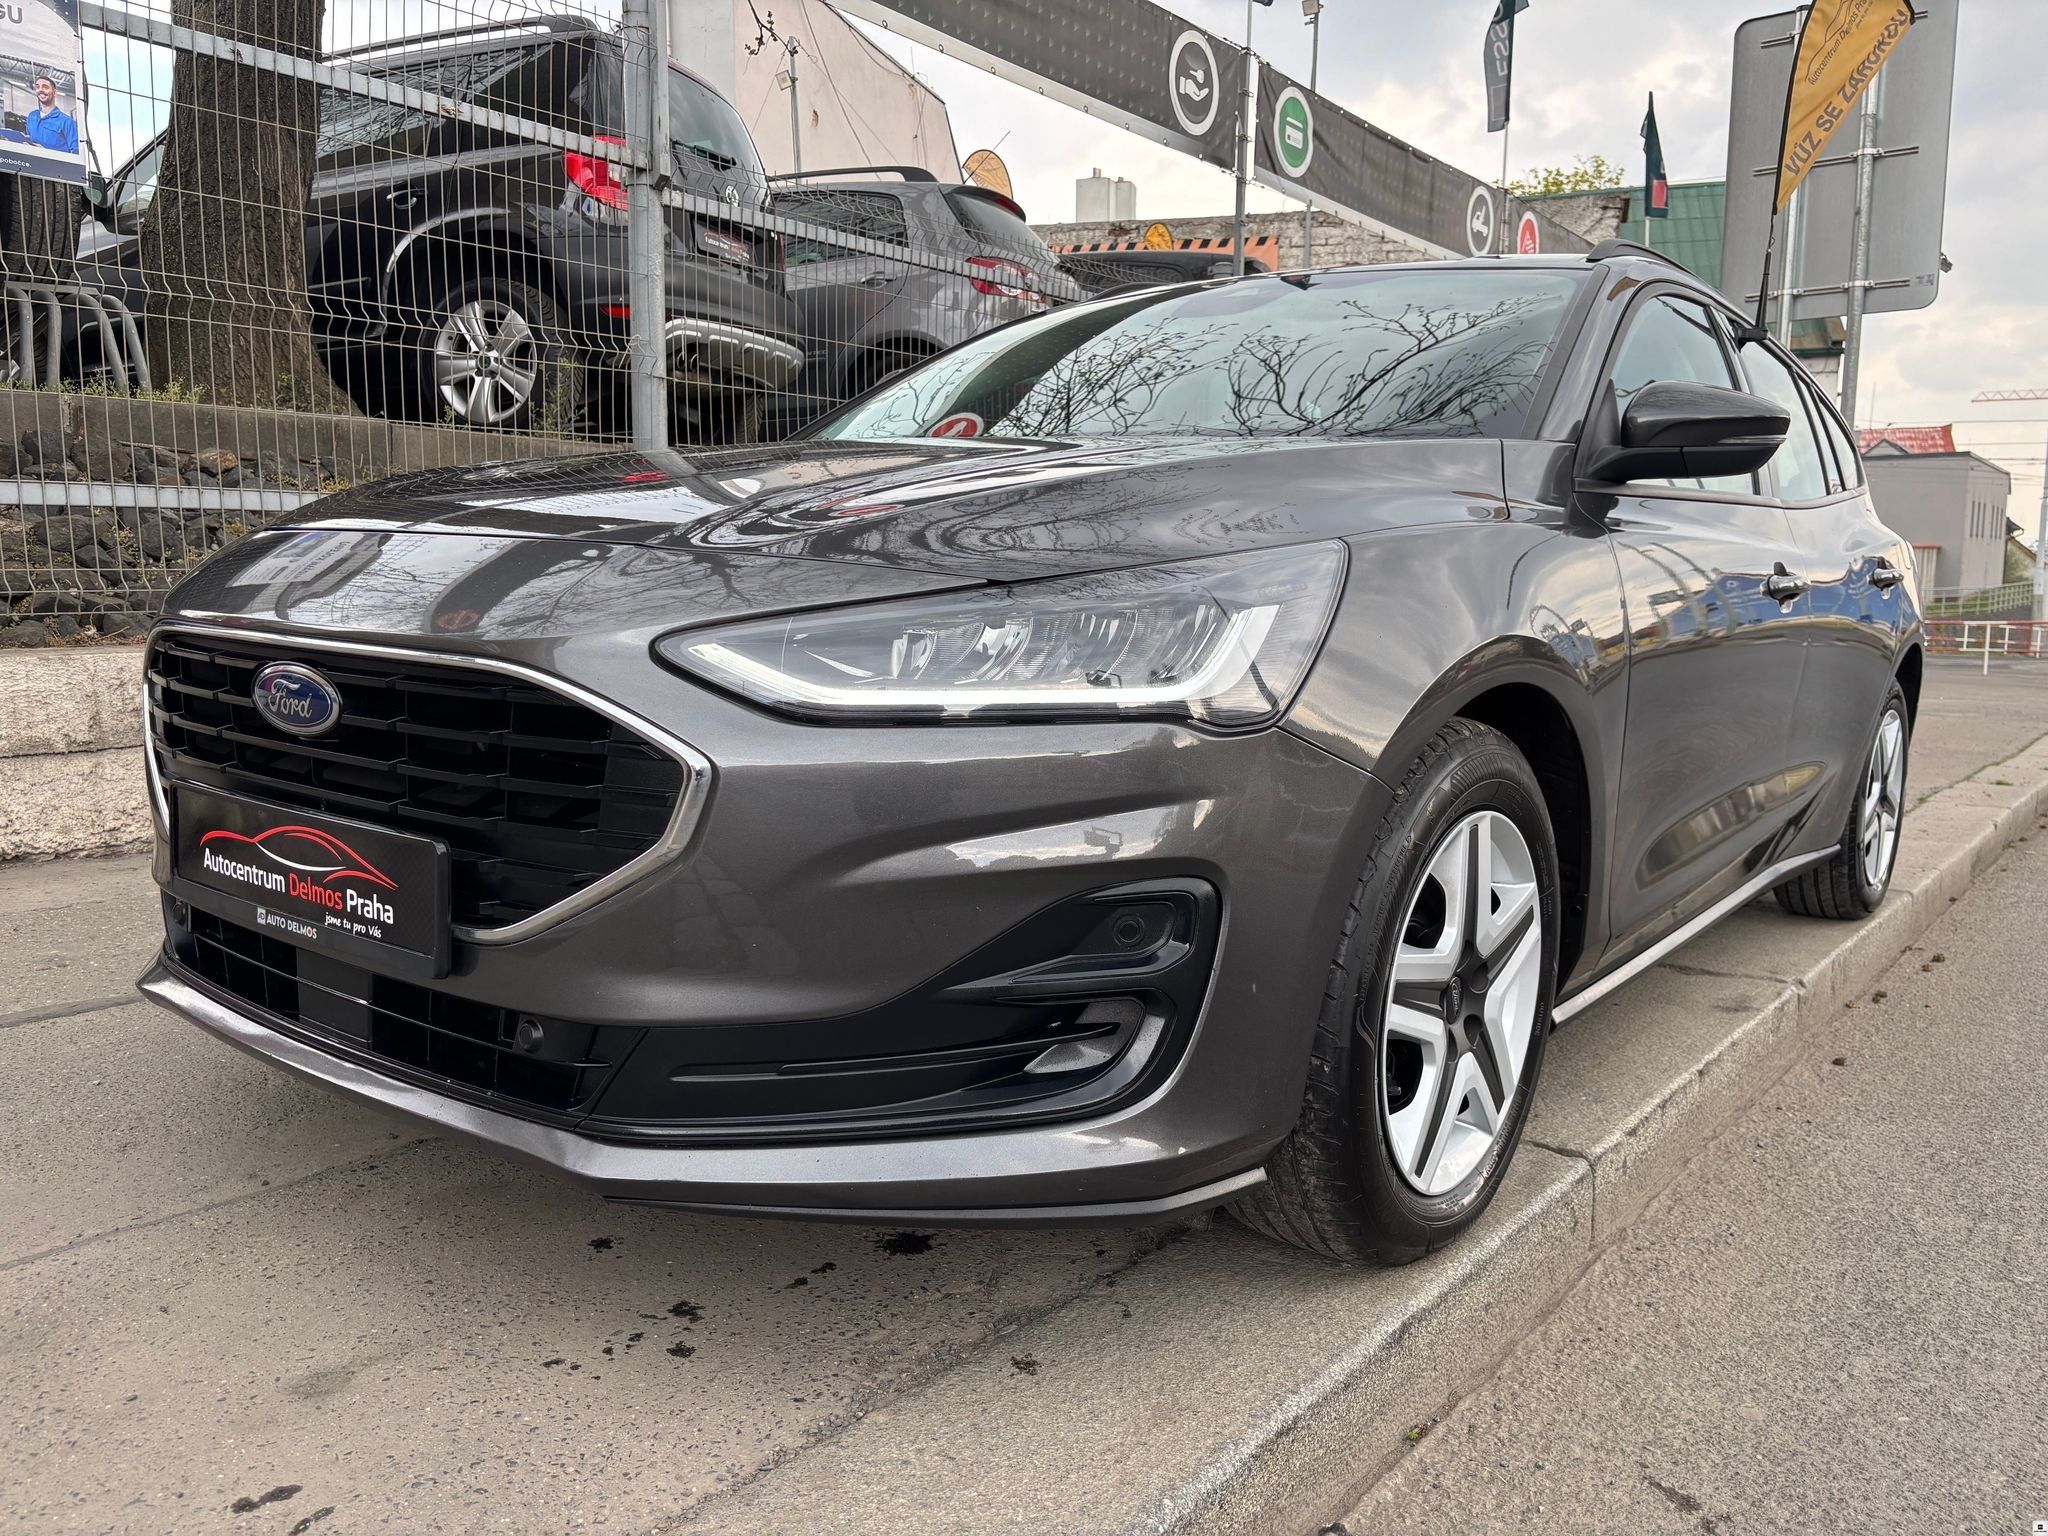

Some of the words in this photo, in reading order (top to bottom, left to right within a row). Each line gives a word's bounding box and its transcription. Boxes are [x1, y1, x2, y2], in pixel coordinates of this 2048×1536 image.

[1815, 101, 1844, 133] SE
[268, 679, 312, 718] Ford
[203, 847, 286, 893] Autocentrum
[289, 872, 344, 910] Delmos
[346, 888, 394, 925] Praha
[267, 913, 286, 929] AUTO
[287, 919, 318, 939] DELMOS
[324, 911, 342, 926] jsme
[343, 918, 352, 930] tu
[353, 922, 367, 937] pro
[368, 925, 382, 938] Vás
